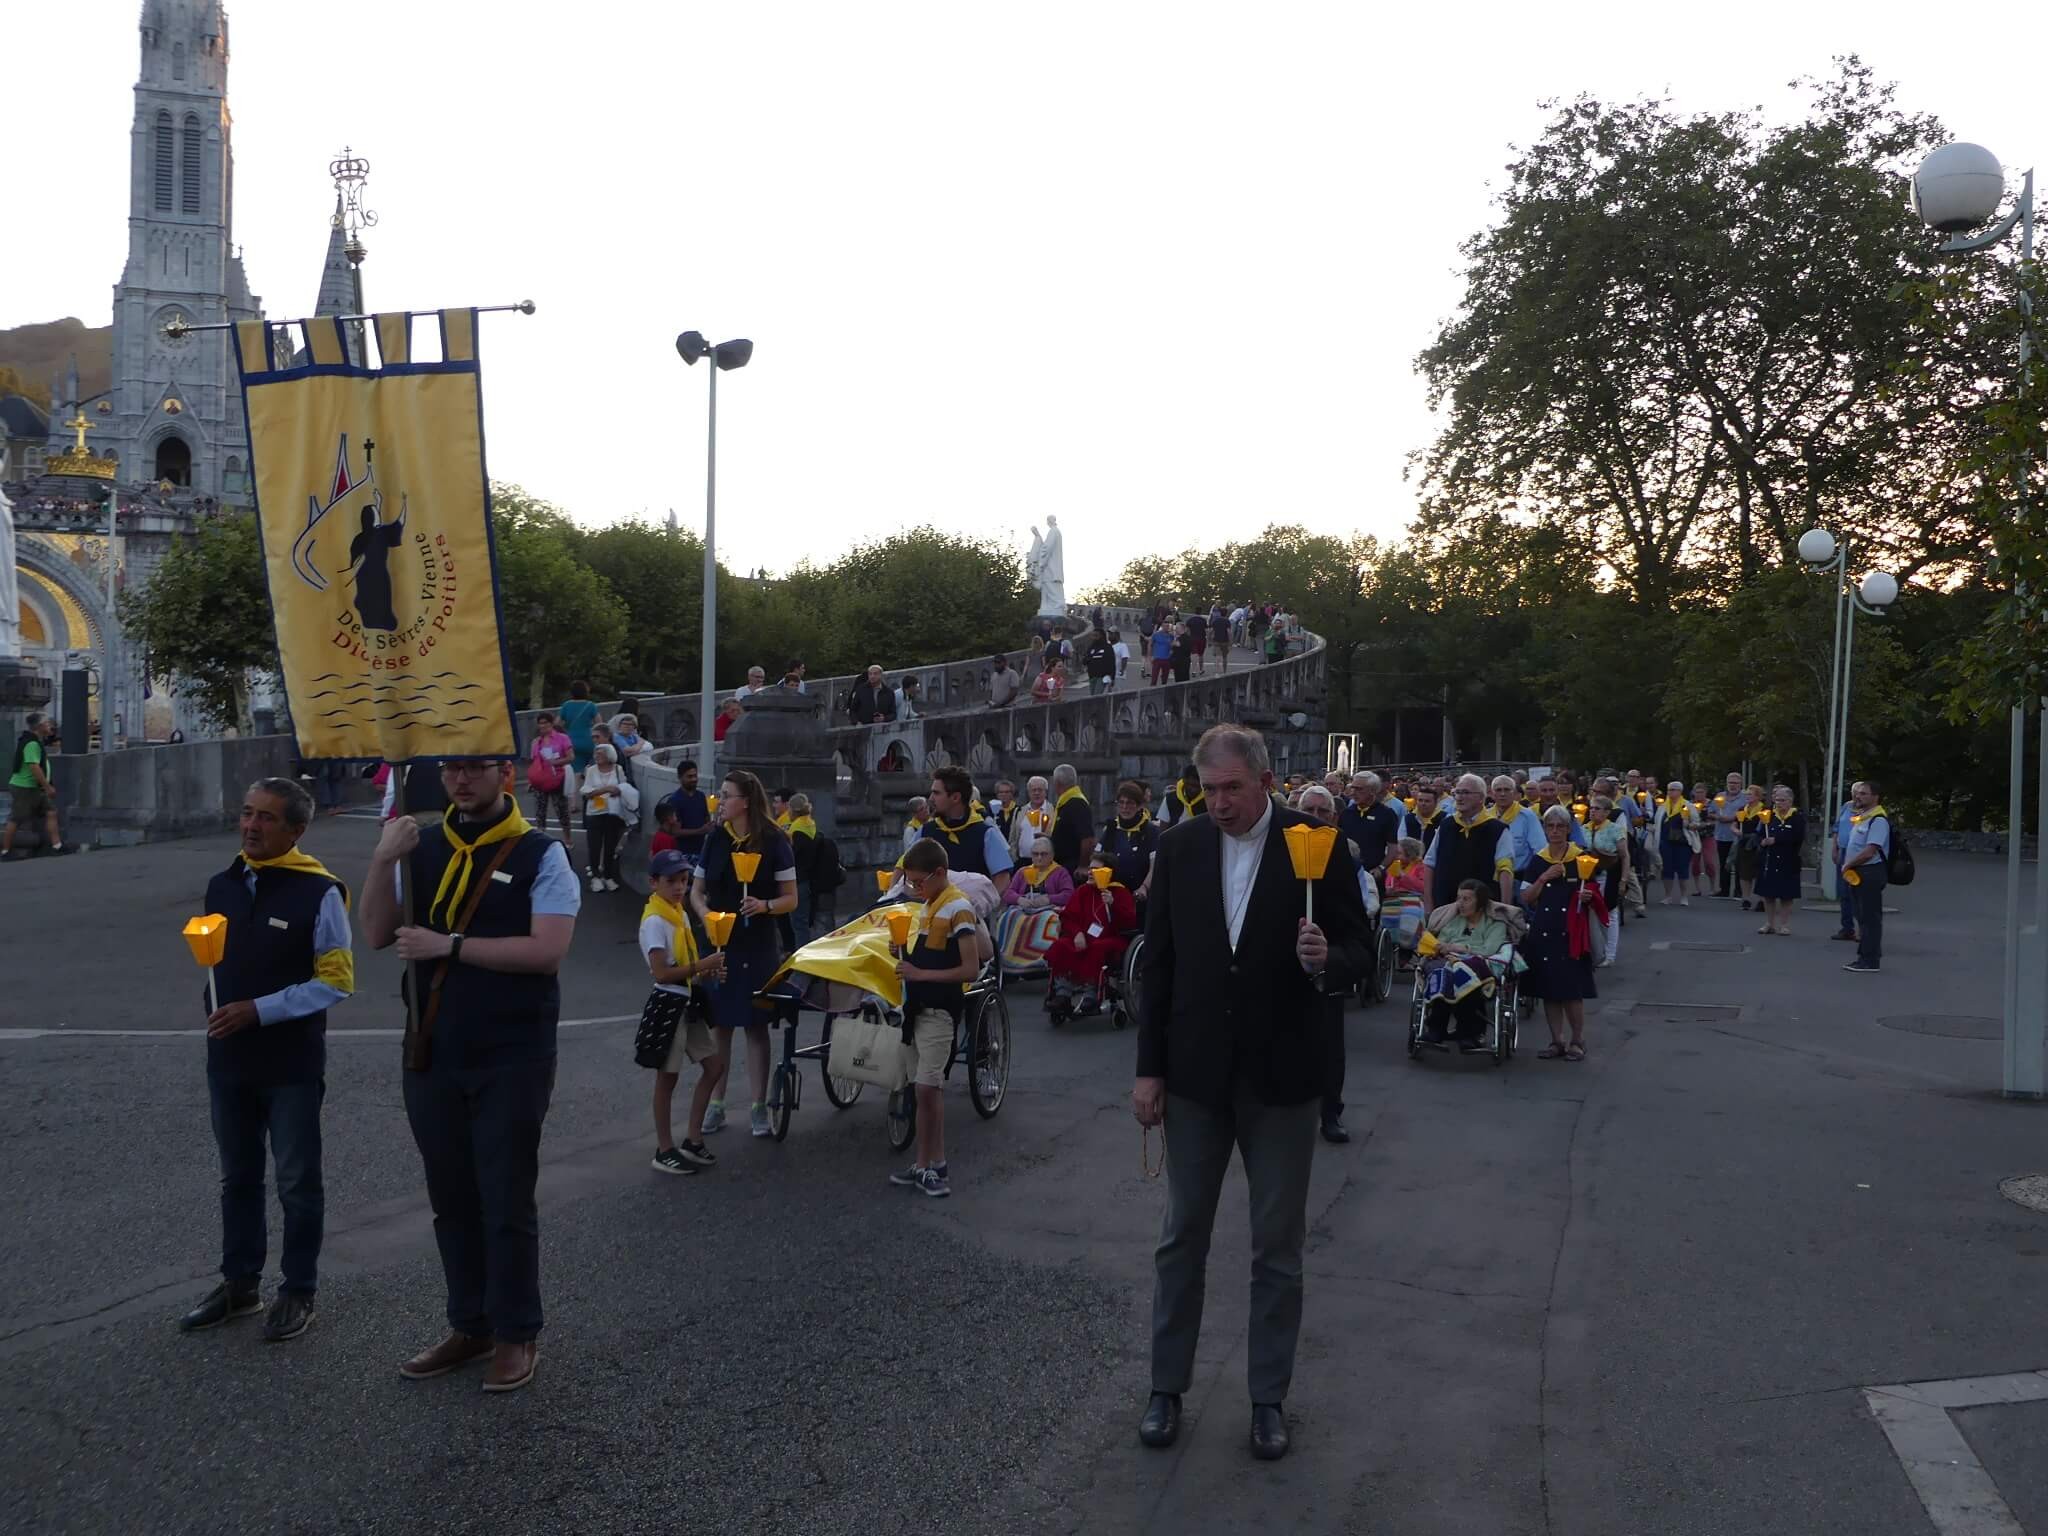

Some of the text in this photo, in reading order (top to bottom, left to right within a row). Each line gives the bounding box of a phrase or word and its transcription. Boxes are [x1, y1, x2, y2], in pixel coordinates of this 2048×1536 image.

[376, 616, 425, 649] Sèvres
[416, 532, 436, 600] Vienne
[419, 635, 436, 657] de
[432, 534, 457, 632] Poitiers
